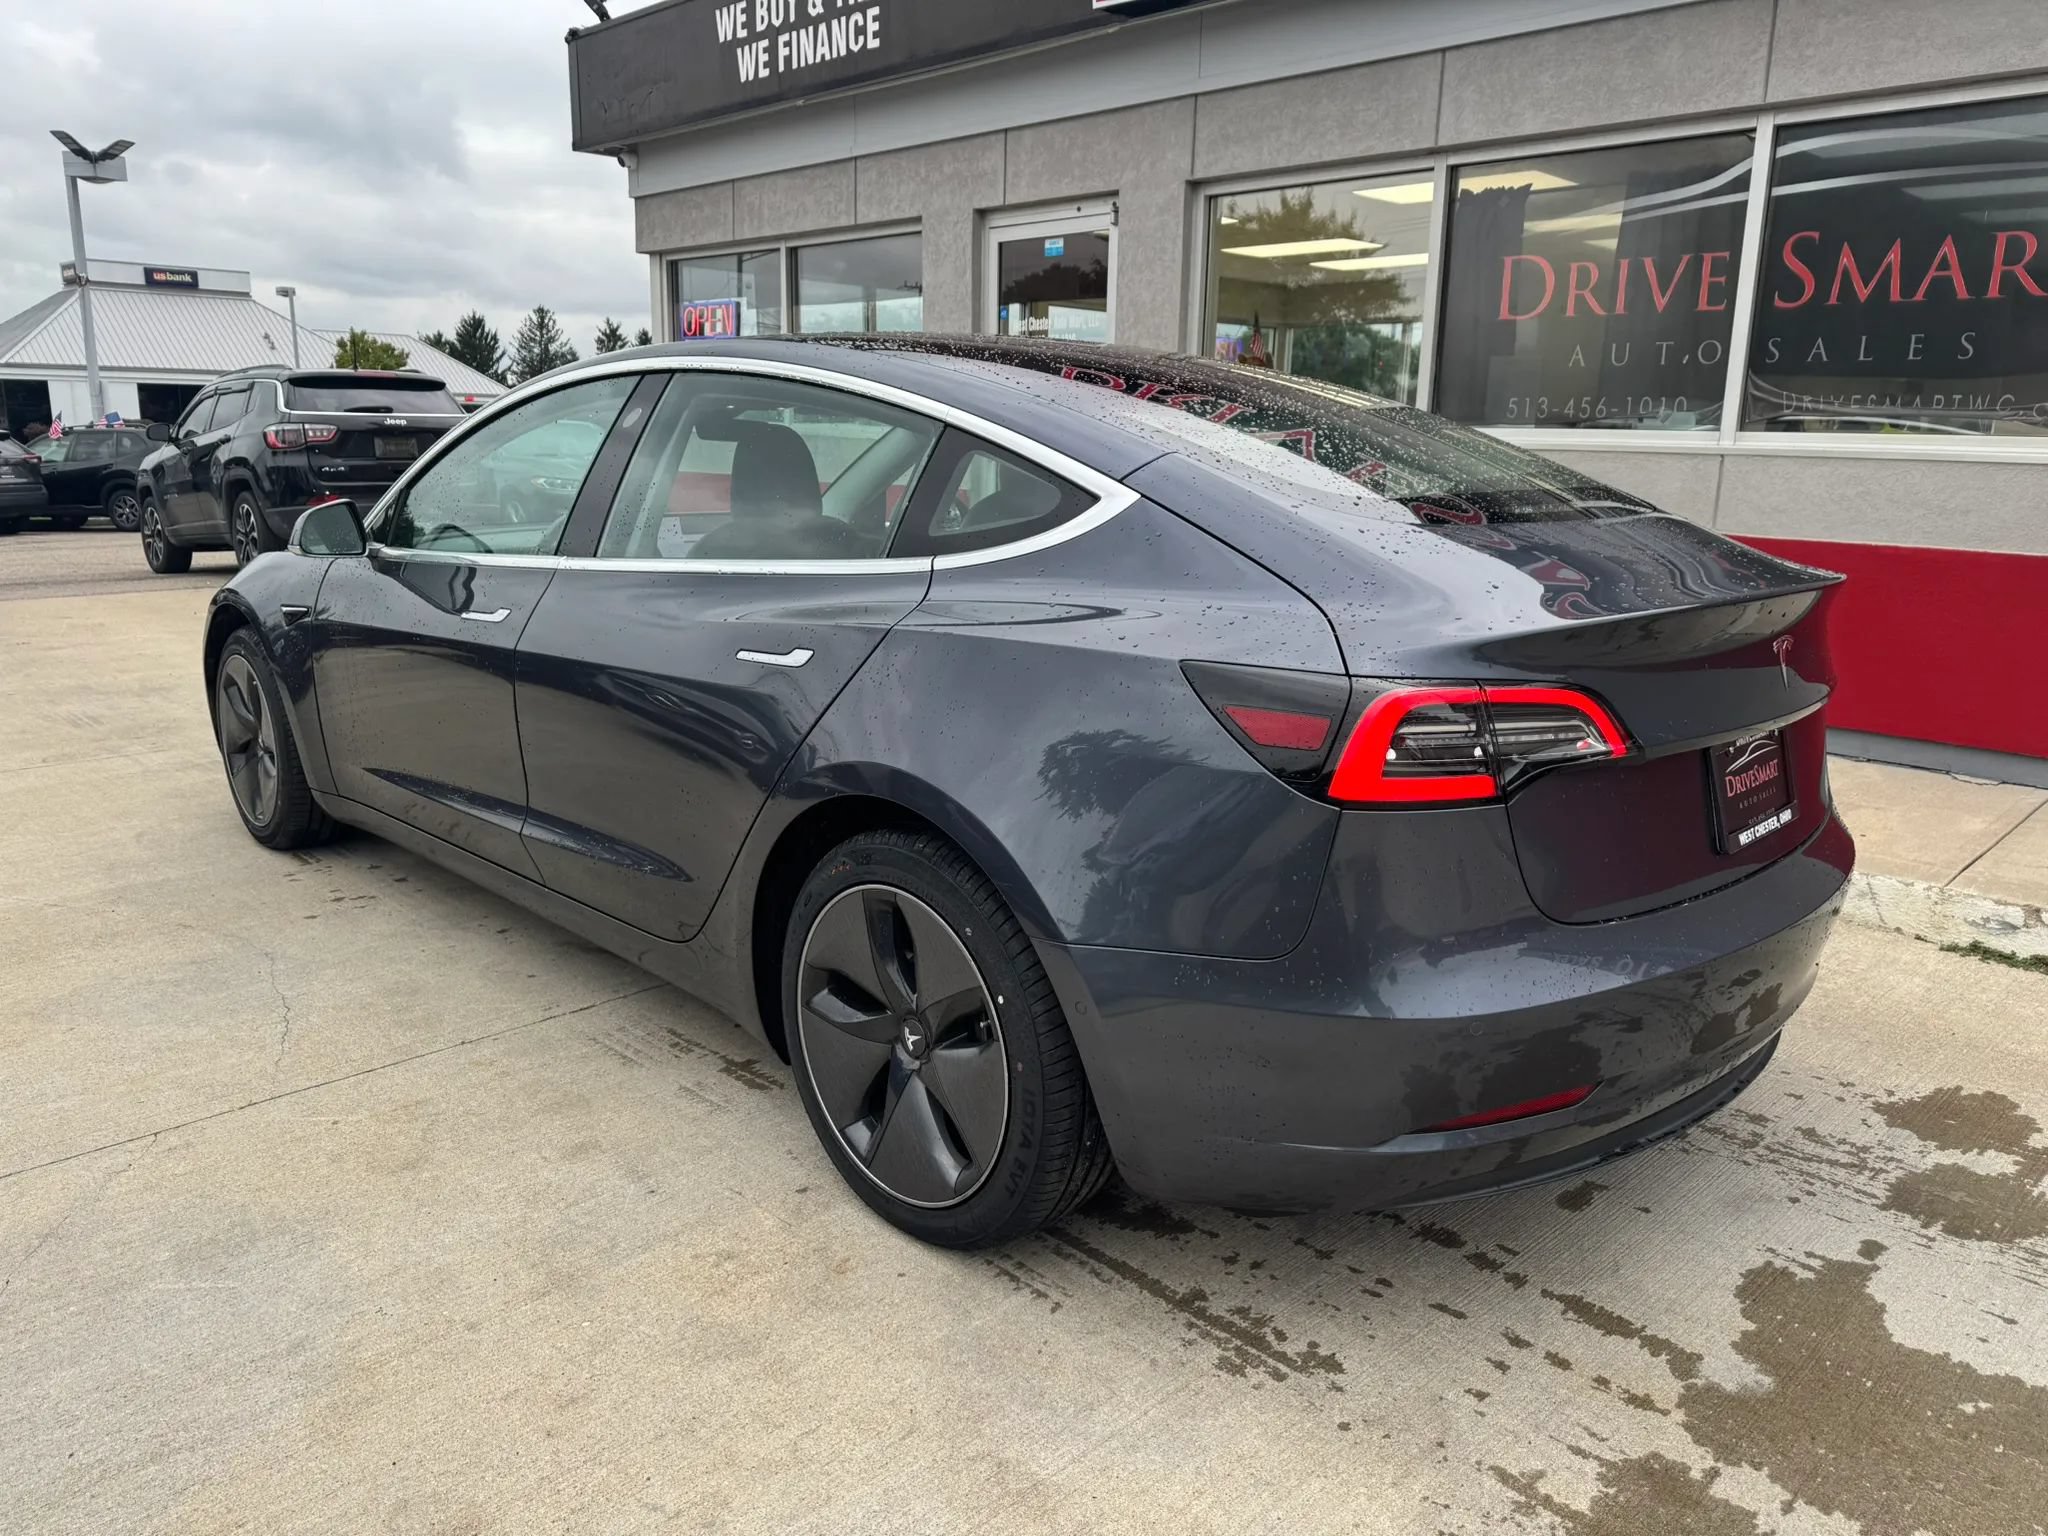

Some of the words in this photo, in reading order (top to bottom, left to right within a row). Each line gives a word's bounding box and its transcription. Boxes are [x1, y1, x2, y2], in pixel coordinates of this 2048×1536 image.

[715, 0, 748, 43] WE
[756, 0, 796, 32] BUY
[807, 0, 824, 17] &
[736, 38, 770, 83] WE
[777, 5, 880, 73] FINANCE
[1498, 251, 1731, 321] DRIVE
[684, 304, 734, 337] OPEN
[1568, 339, 1722, 367] AUTO
[1765, 331, 1976, 363] SALES
[383, 417, 407, 427] Jeep
[1506, 395, 1689, 419] 513-456-1010
[1738, 827, 1756, 846] WEST
[1755, 815, 1781, 839] CHESTER,
[1779, 808, 1793, 825] OHIO
